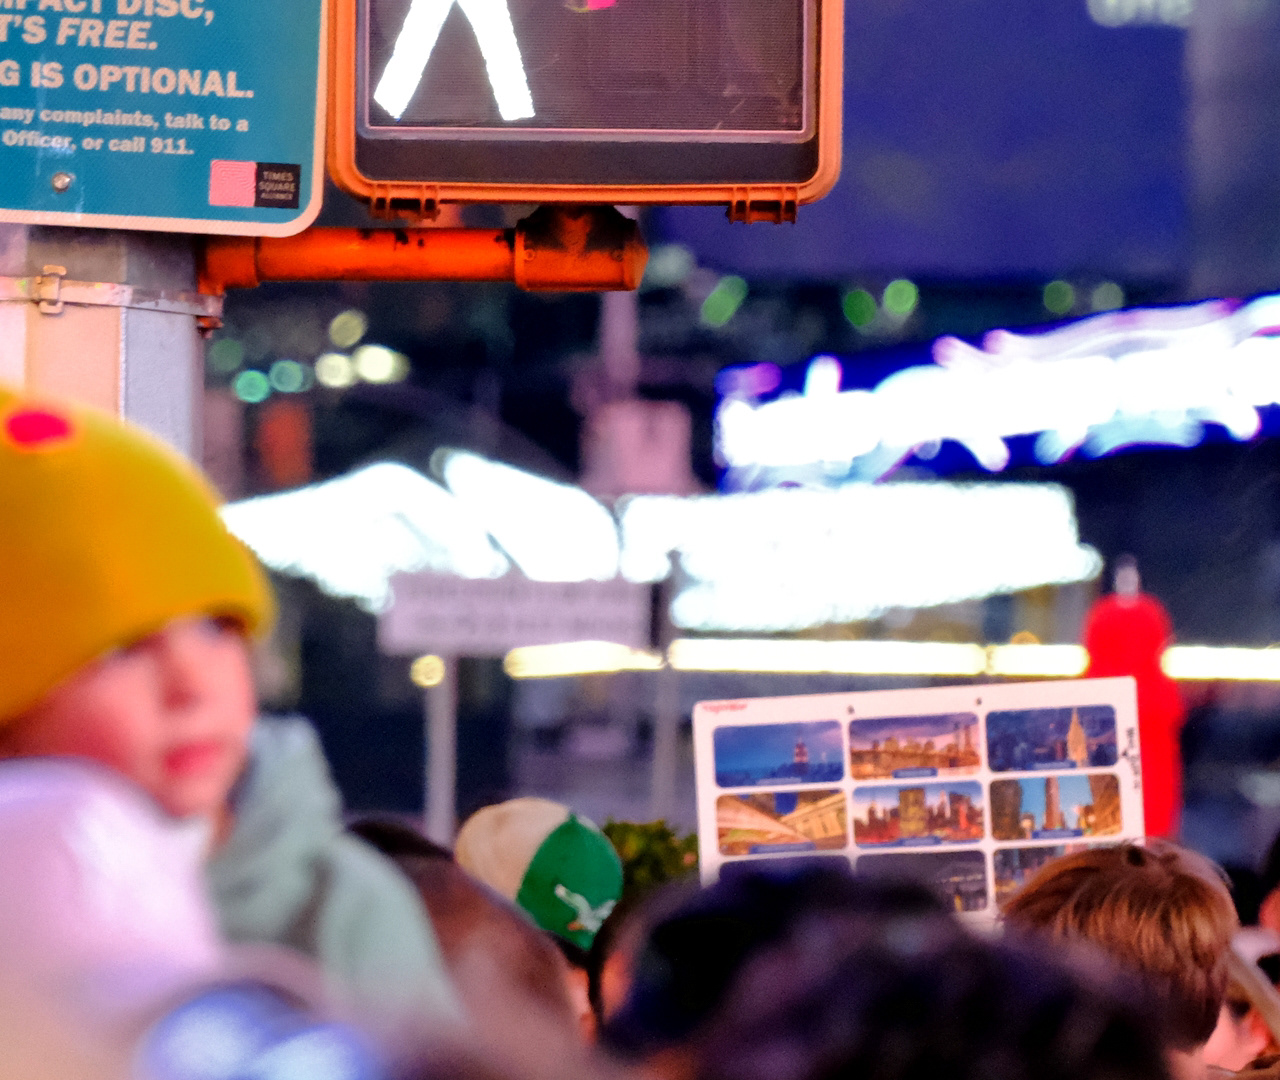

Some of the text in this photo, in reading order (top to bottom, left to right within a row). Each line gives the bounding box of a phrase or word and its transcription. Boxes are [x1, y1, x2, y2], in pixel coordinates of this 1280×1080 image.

[56, 17, 158, 50] FREE.
[31, 61, 63, 88] IS
[74, 63, 254, 98] OPTIONAL.
[0, 106, 35, 124] any
[39, 108, 159, 130] complaints,
[164, 113, 204, 130] talk
[209, 114, 231, 130] to
[236, 118, 249, 132] a
[3, 128, 76, 151] Officer,
[82, 137, 104, 151] or
[108, 135, 145, 153] call
[151, 137, 194, 155] 911.
[263, 171, 294, 181] TIMES
